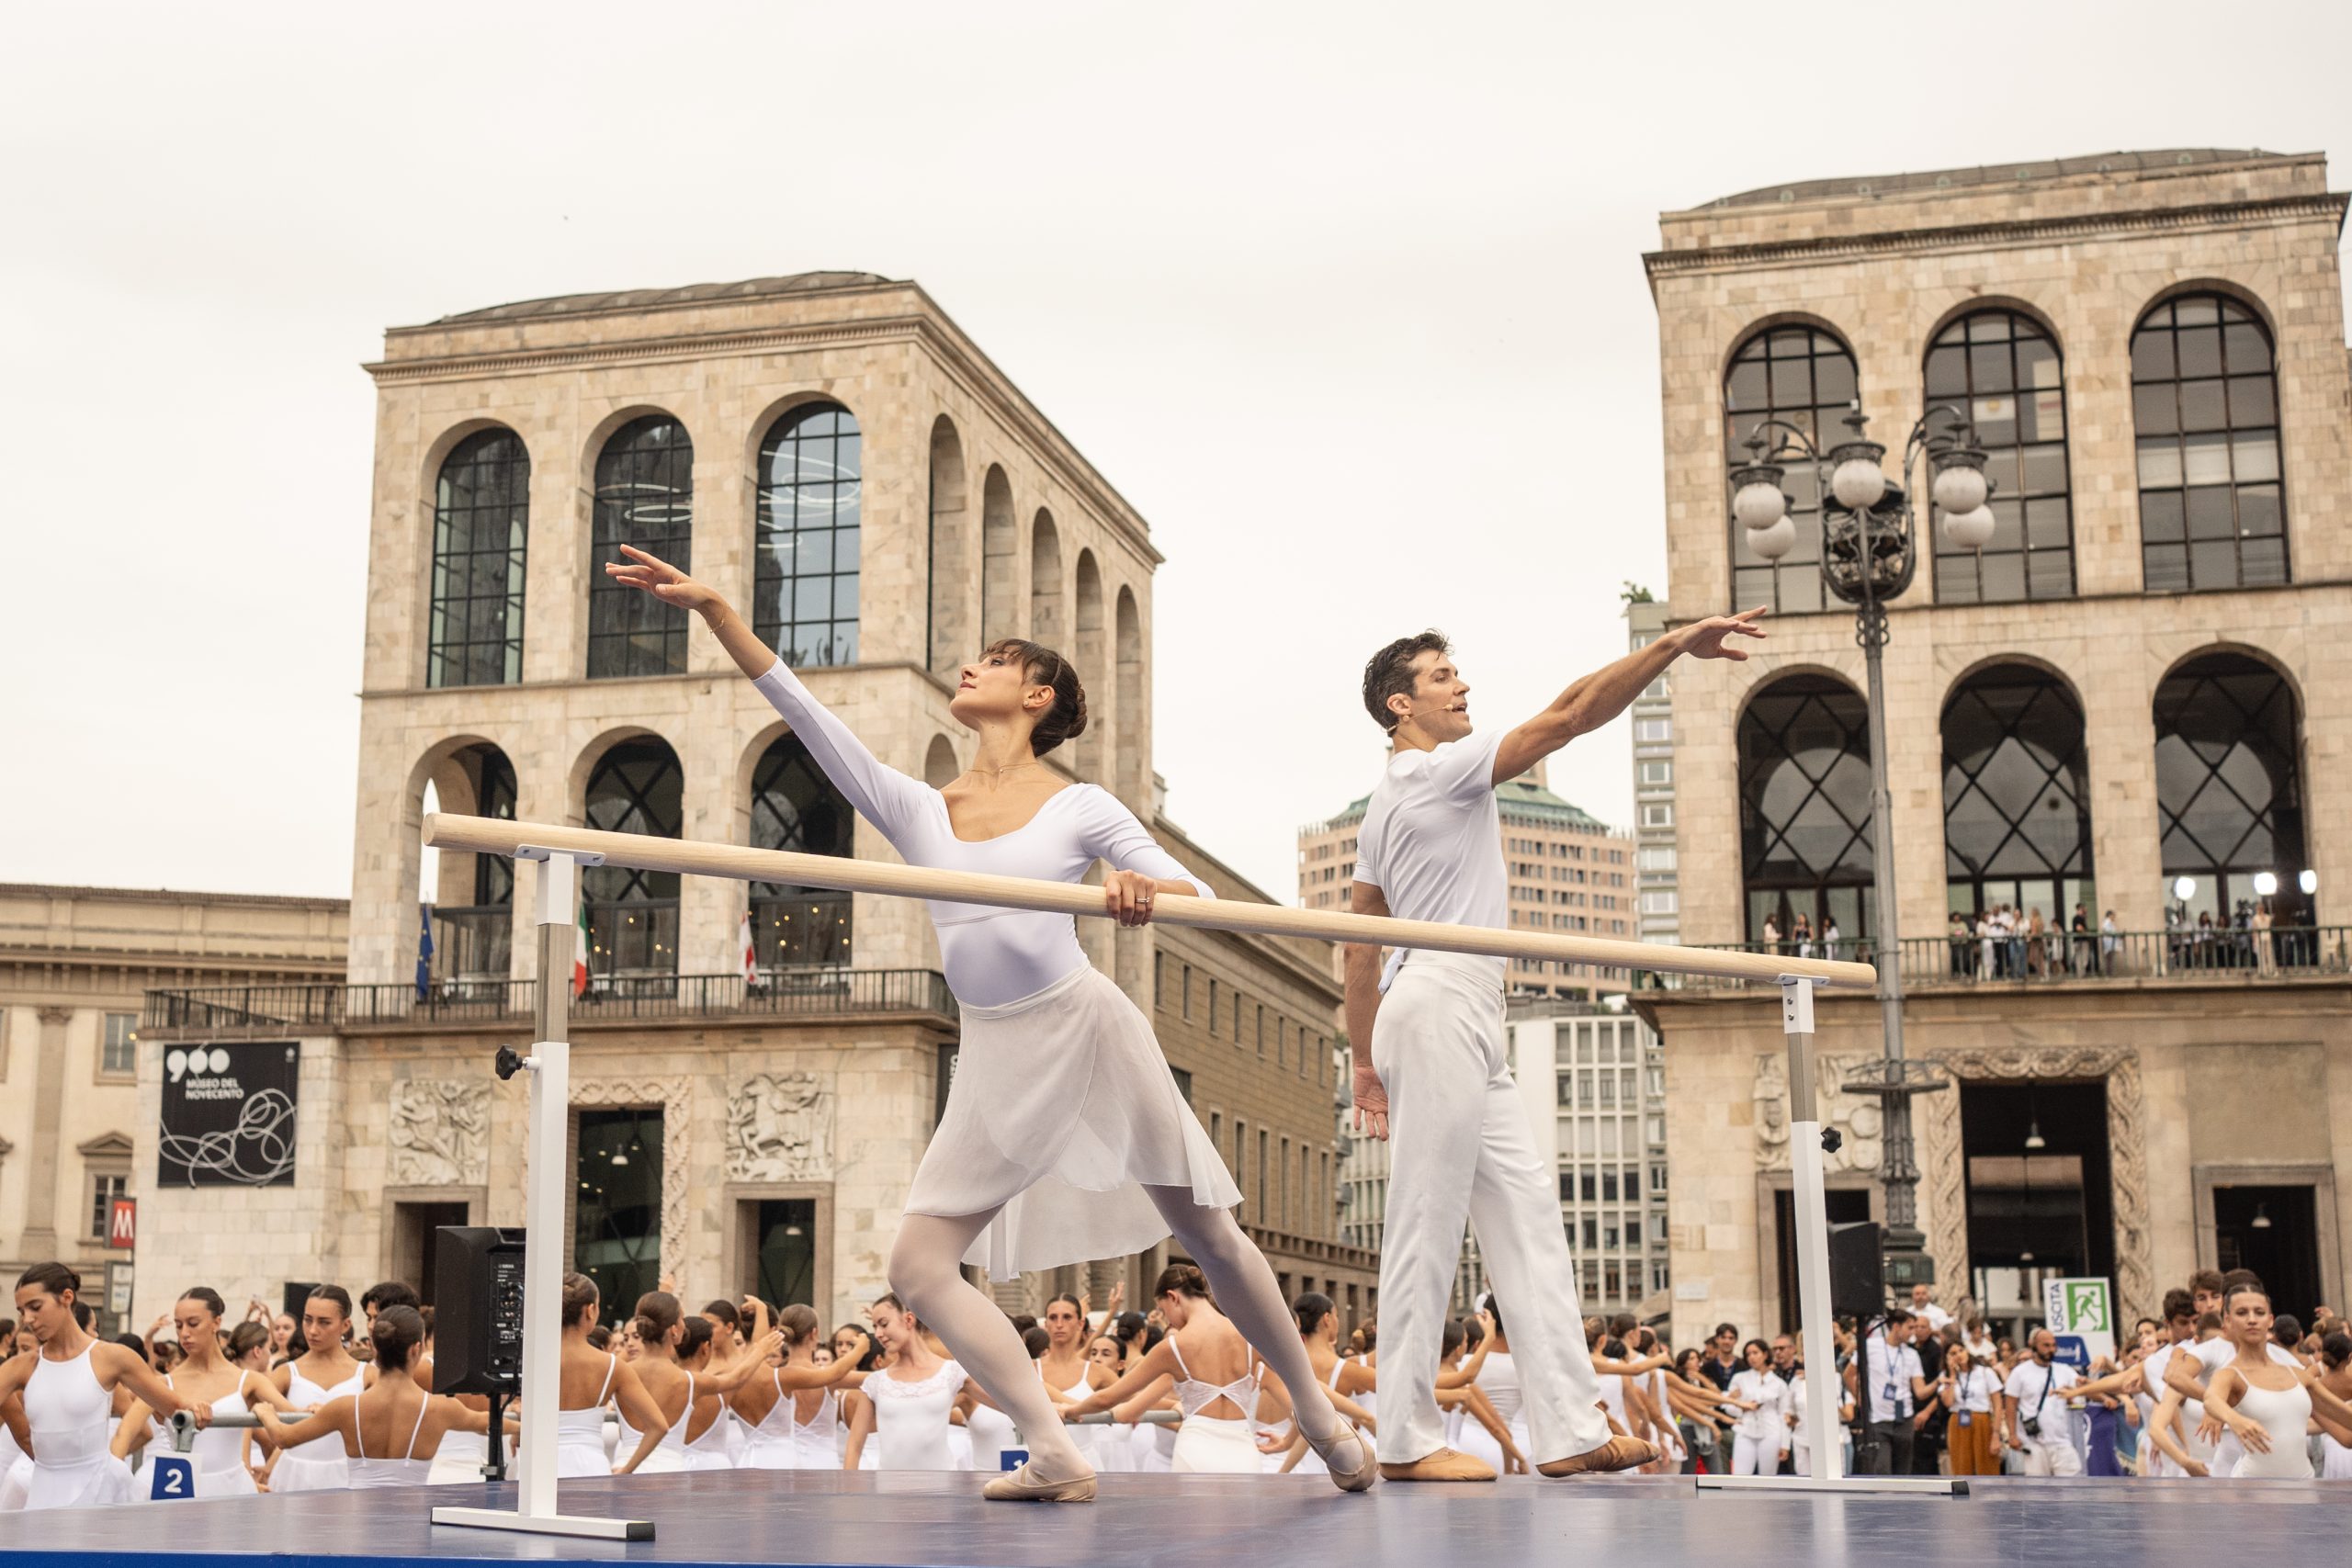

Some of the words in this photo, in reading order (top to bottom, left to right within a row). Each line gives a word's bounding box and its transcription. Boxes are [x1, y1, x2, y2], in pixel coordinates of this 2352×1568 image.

[166, 1048, 230, 1083] 900
[185, 1088, 244, 1100] NOVECENTO
[186, 1077, 220, 1089] MUSEO
[220, 1077, 239, 1089] DEL
[113, 1208, 134, 1238] M
[2050, 1282, 2064, 1333] USCITA
[164, 1468, 183, 1494] 2
